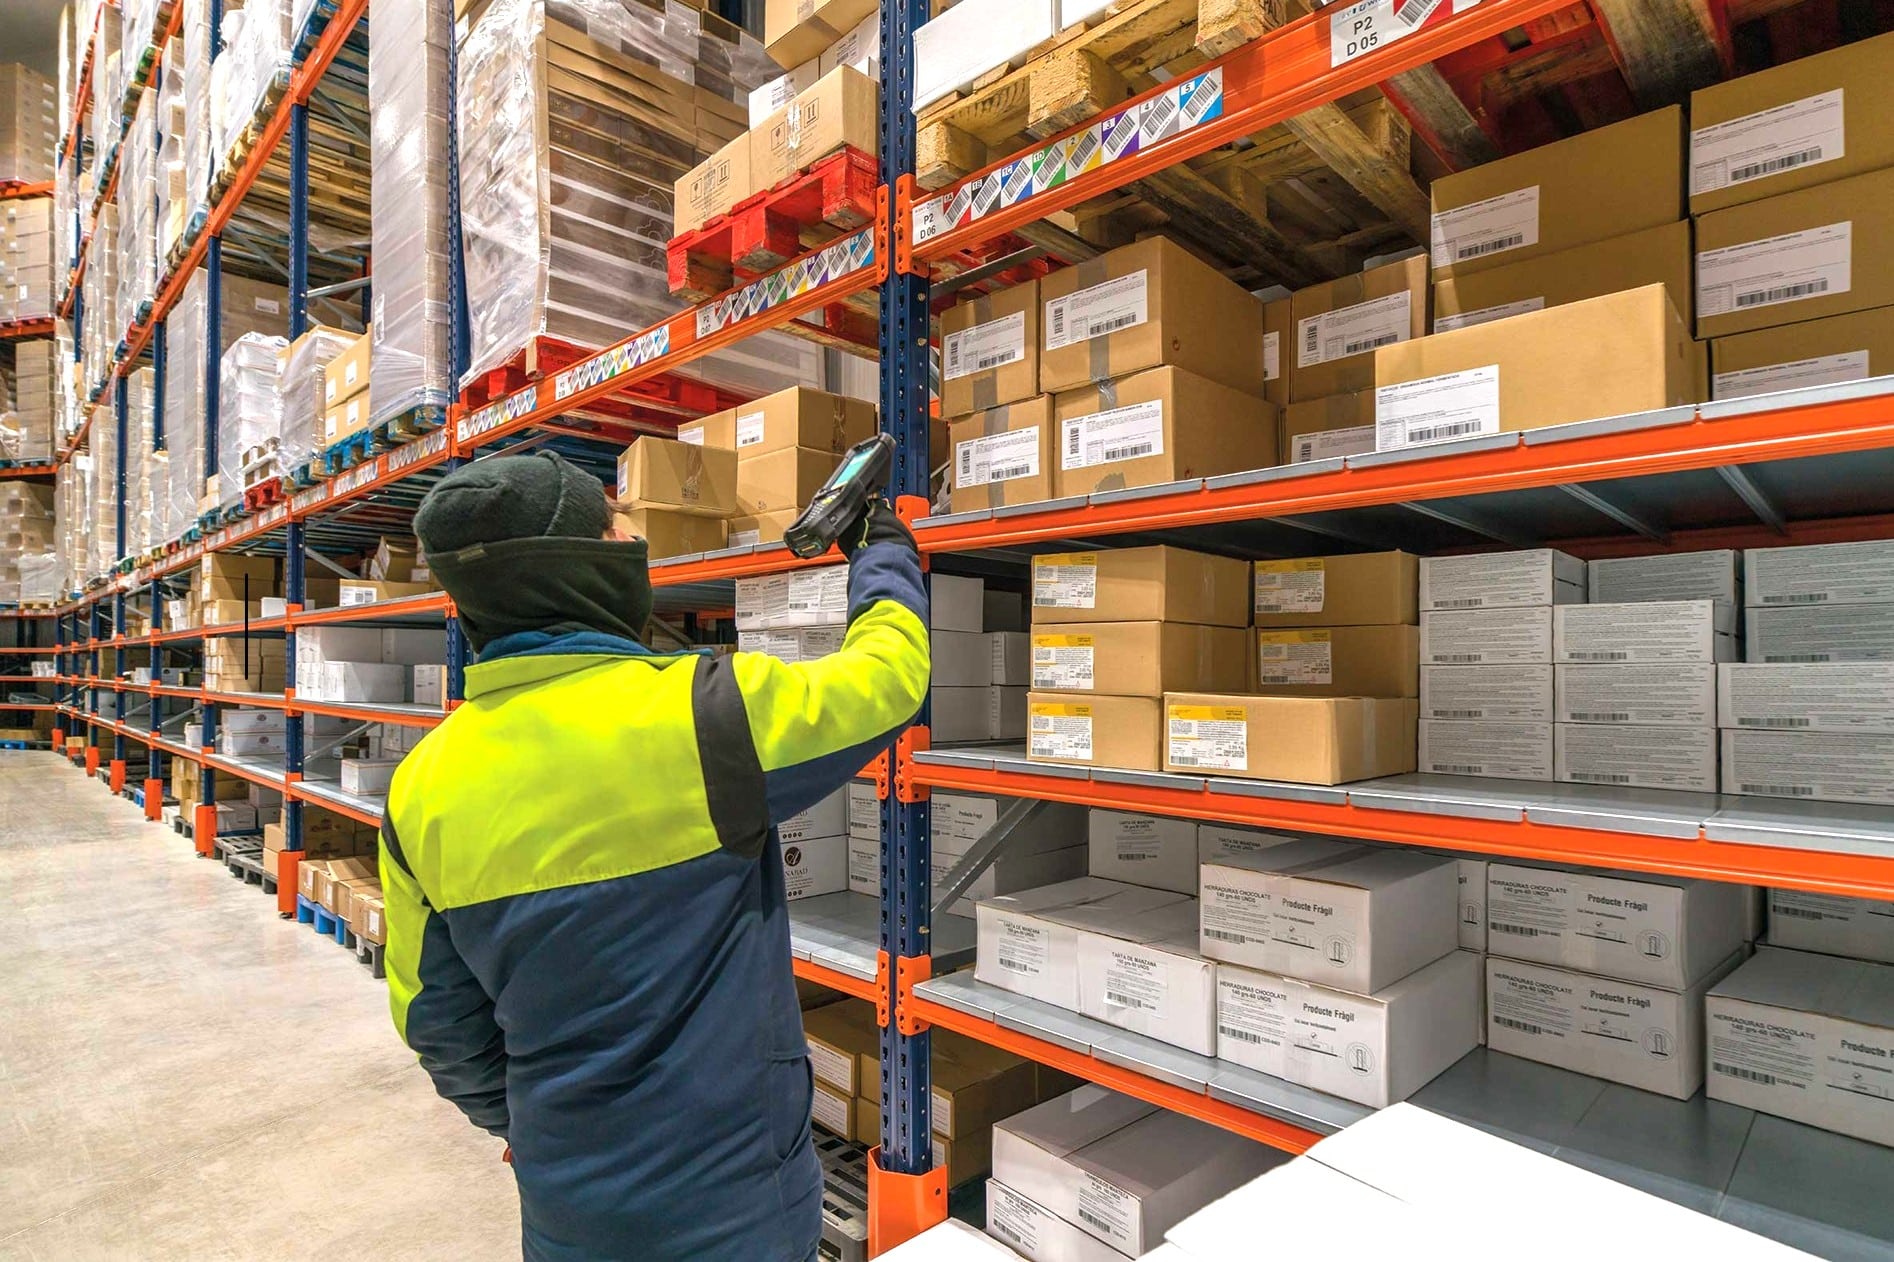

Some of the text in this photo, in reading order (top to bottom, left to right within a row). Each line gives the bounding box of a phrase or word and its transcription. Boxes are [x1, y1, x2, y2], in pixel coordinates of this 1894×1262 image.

[1353, 16, 1373, 35] P2
[1346, 32, 1378, 56] D 05
[1185, 84, 1191, 93] 5
[1144, 102, 1150, 111] 4
[1106, 120, 1111, 129] 3
[1070, 136, 1076, 145] 2
[1004, 167, 1012, 175] 1C
[923, 213, 934, 225] P2
[920, 225, 936, 240] D 06
[1239, 890, 1271, 901] CHOCOLATE
[1530, 884, 1567, 895] CHOCOLATE
[1282, 898, 1333, 917] Producte Fràgil
[1587, 894, 1648, 912] Producte Fràgil
[1219, 980, 1287, 1001] HERRADURAS CHOCOLATE
[1590, 990, 1625, 1004] Producte
[1303, 1002, 1355, 1023] Producte Fràgil
[1840, 1039, 1887, 1058] Producte
